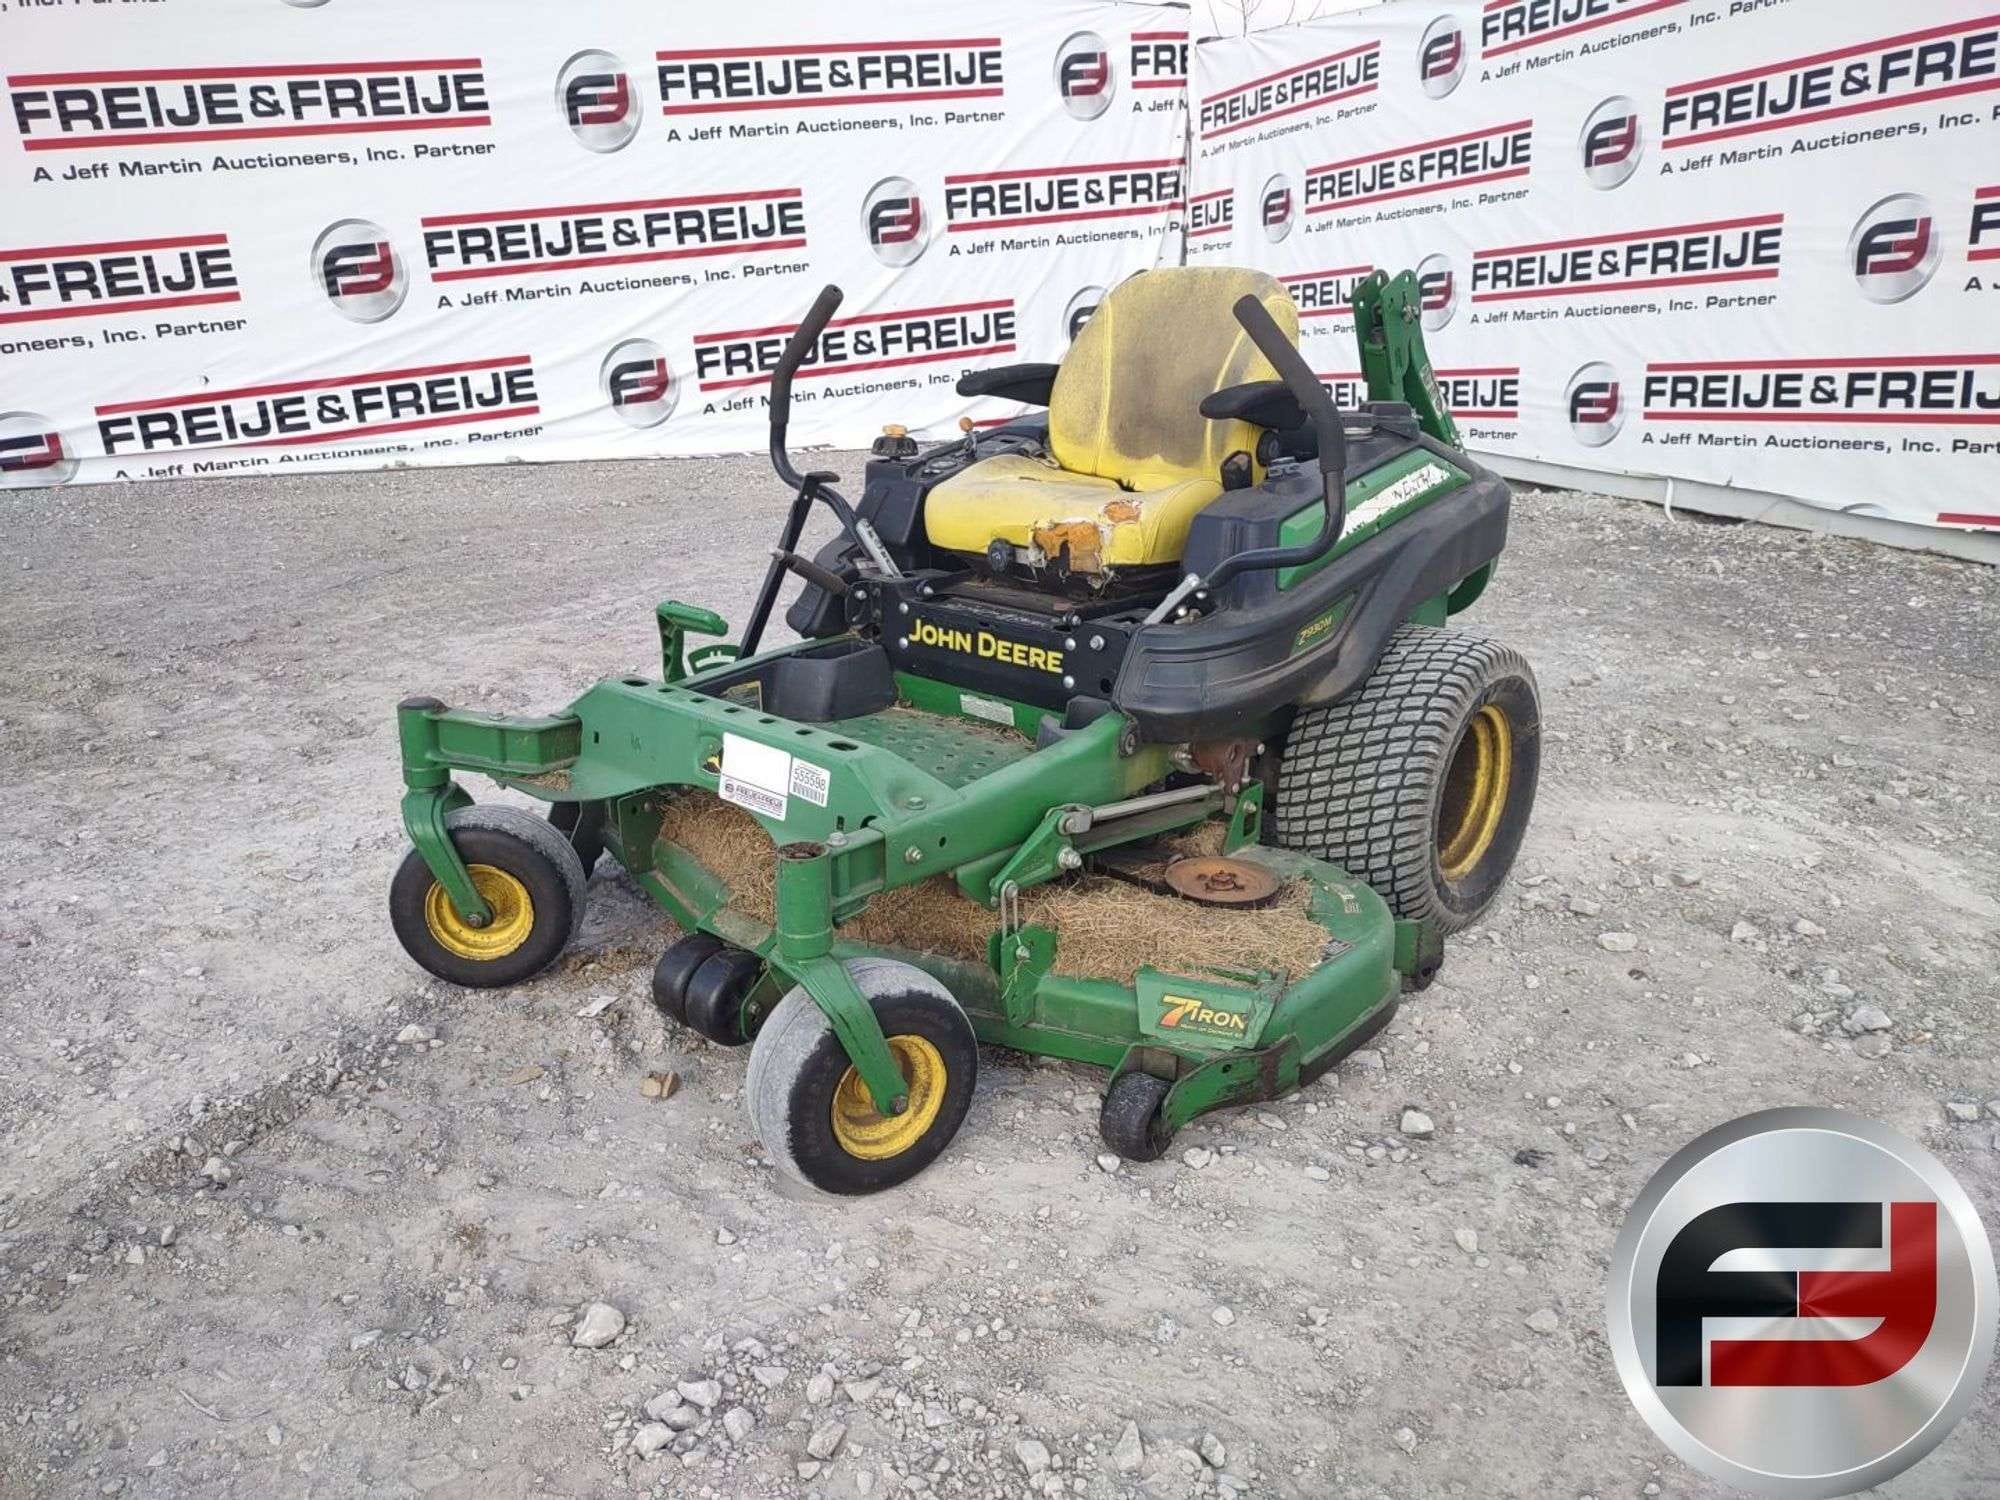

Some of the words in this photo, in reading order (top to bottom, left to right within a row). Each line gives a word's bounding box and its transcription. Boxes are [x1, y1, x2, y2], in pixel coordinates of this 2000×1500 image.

[1480, 70, 1491, 82] A
[1495, 61, 1521, 78] Jeff
[1526, 49, 1574, 70] Martin
[1580, 22, 1682, 56] Auctioneers,
[1690, 12, 1721, 27] Inc.
[1132, 101, 1142, 112] A
[1148, 99, 1174, 112] Jeff
[667, 129, 681, 142] A
[688, 126, 722, 141] Jeff
[729, 123, 789, 138] Martin
[796, 118, 903, 134] Auctioneers,
[910, 114, 938, 126] Inc.
[945, 112, 1005, 124] Partner
[1660, 162, 1673, 176] A
[1679, 154, 1713, 172] Jeff
[1719, 144, 1783, 166] Martin
[1790, 122, 1927, 154] Auctioneers,
[1939, 113, 1980, 129] Inc.
[33, 167, 54, 183] A
[62, 162, 110, 180] Jeff
[118, 158, 202, 177] Martin
[212, 152, 358, 171] Auctioneers,
[366, 147, 405, 162] Inc.
[413, 144, 496, 158] Partner
[1305, 224, 1312, 233] A
[1315, 220, 1333, 232] Jeff
[1336, 215, 1371, 228] Martin
[1375, 204, 1447, 222] Auctioneers,
[1452, 199, 1473, 209] Inc.
[1478, 189, 1529, 205] Partner
[949, 245, 961, 256] A
[967, 241, 995, 254] Jeff
[1001, 236, 1049, 251] Martin
[1056, 230, 1144, 247] Auctioneers,
[438, 295, 453, 309] A
[461, 290, 498, 306] Jeff
[505, 284, 571, 302] Martin
[579, 275, 697, 294] Auctioneers,
[704, 270, 735, 282] Inc.
[743, 263, 810, 278] Partner
[1470, 314, 1479, 324] A
[1484, 311, 1508, 323] Jeff
[1513, 308, 1558, 321] Martin
[1564, 303, 1661, 318] Auctioneers,
[1669, 299, 1698, 311] Inc.
[1705, 295, 1777, 309] Partner
[102, 329, 146, 344] Inc.
[155, 319, 247, 338] Partner
[703, 403, 716, 415] A
[722, 397, 754, 412] Jeff
[823, 379, 922, 399] Auctioneers,
[928, 374, 954, 384] Inc.
[1469, 427, 1518, 440] Partner
[1641, 432, 1654, 444] A
[1660, 432, 1692, 445] Jeff
[1698, 433, 1758, 447] Martin
[1764, 435, 1891, 454] Auctioneers,
[1902, 438, 1941, 453] Inc.
[908, 618, 972, 654] JOHN
[977, 632, 1064, 674] DEERE
[794, 768, 826, 792] 555598
